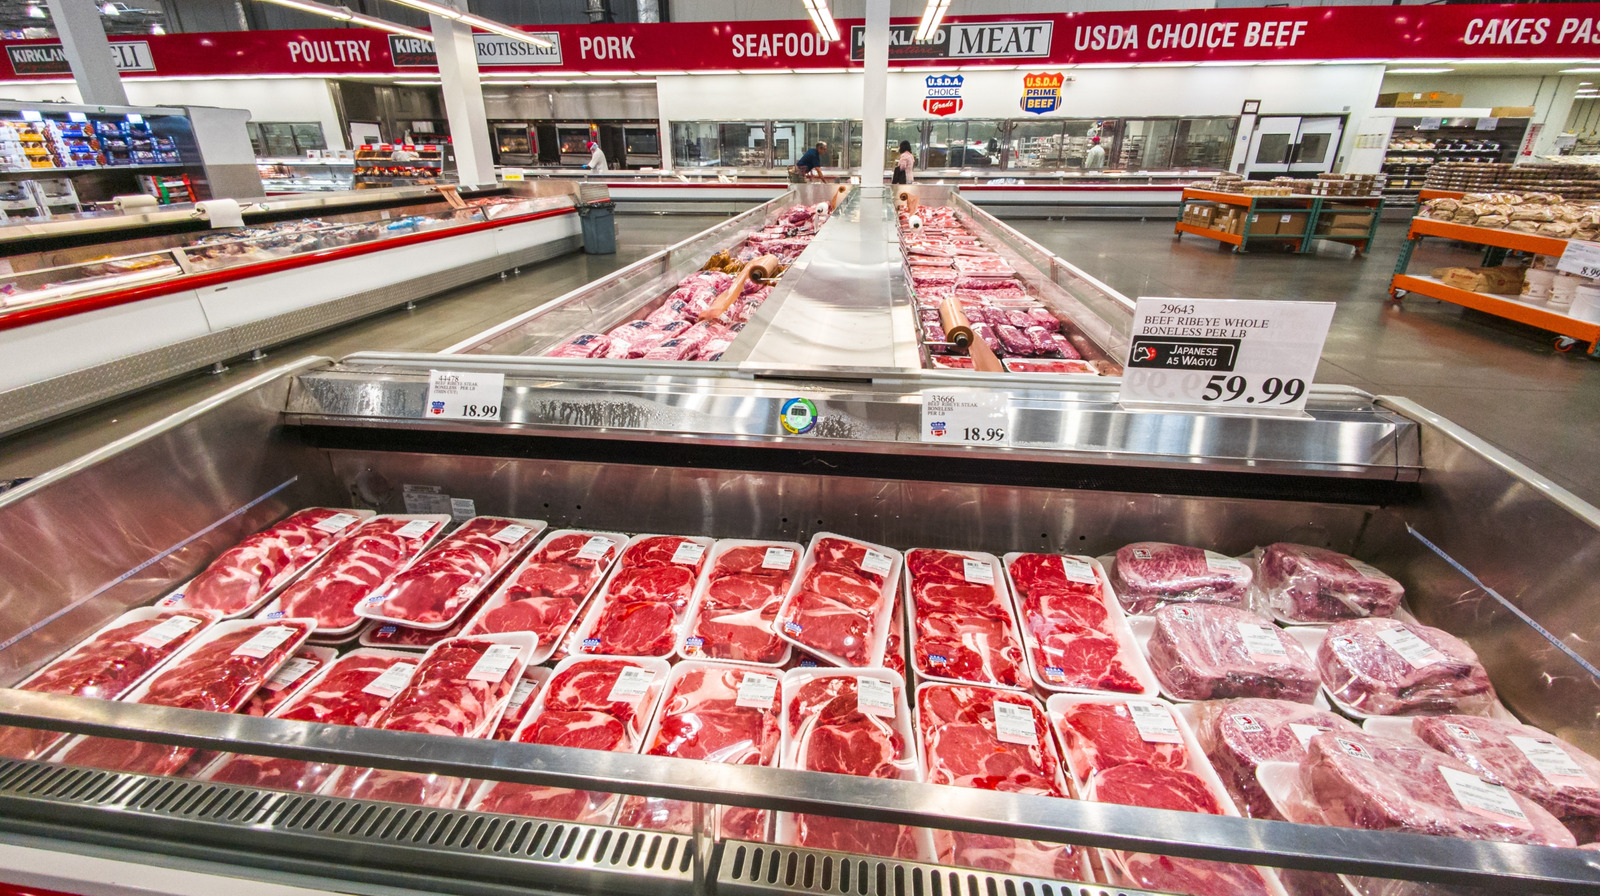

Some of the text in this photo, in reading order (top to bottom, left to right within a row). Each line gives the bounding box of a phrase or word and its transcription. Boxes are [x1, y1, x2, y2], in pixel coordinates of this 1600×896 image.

[858, 29, 946, 46] KKLAD
[1074, 20, 1308, 51] USDA CHOICE BEEF
[1463, 18, 1551, 45] CAKES
[732, 32, 829, 58] SEAFOOD
[957, 26, 1042, 54] MEAT
[288, 40, 370, 63] POULTRY
[579, 36, 636, 60] PORK
[928, 78, 961, 86] U.S.D.A.
[1026, 77, 1060, 87] U.S.D.A.
[928, 88, 960, 96] CHOICE
[1026, 88, 1058, 96] PRIME
[932, 101, 954, 112] Grade
[1027, 98, 1054, 108] BEEF
[1160, 304, 1195, 314] 29643
[1144, 316, 1270, 328] BEEF RIBEYE WHOLE
[1142, 326, 1247, 338] BONELESS PER LB
[1202, 375, 1305, 405] 59.99
[932, 395, 955, 403] 33666
[462, 404, 498, 418] 18.99
[964, 427, 1004, 442] 18.99
